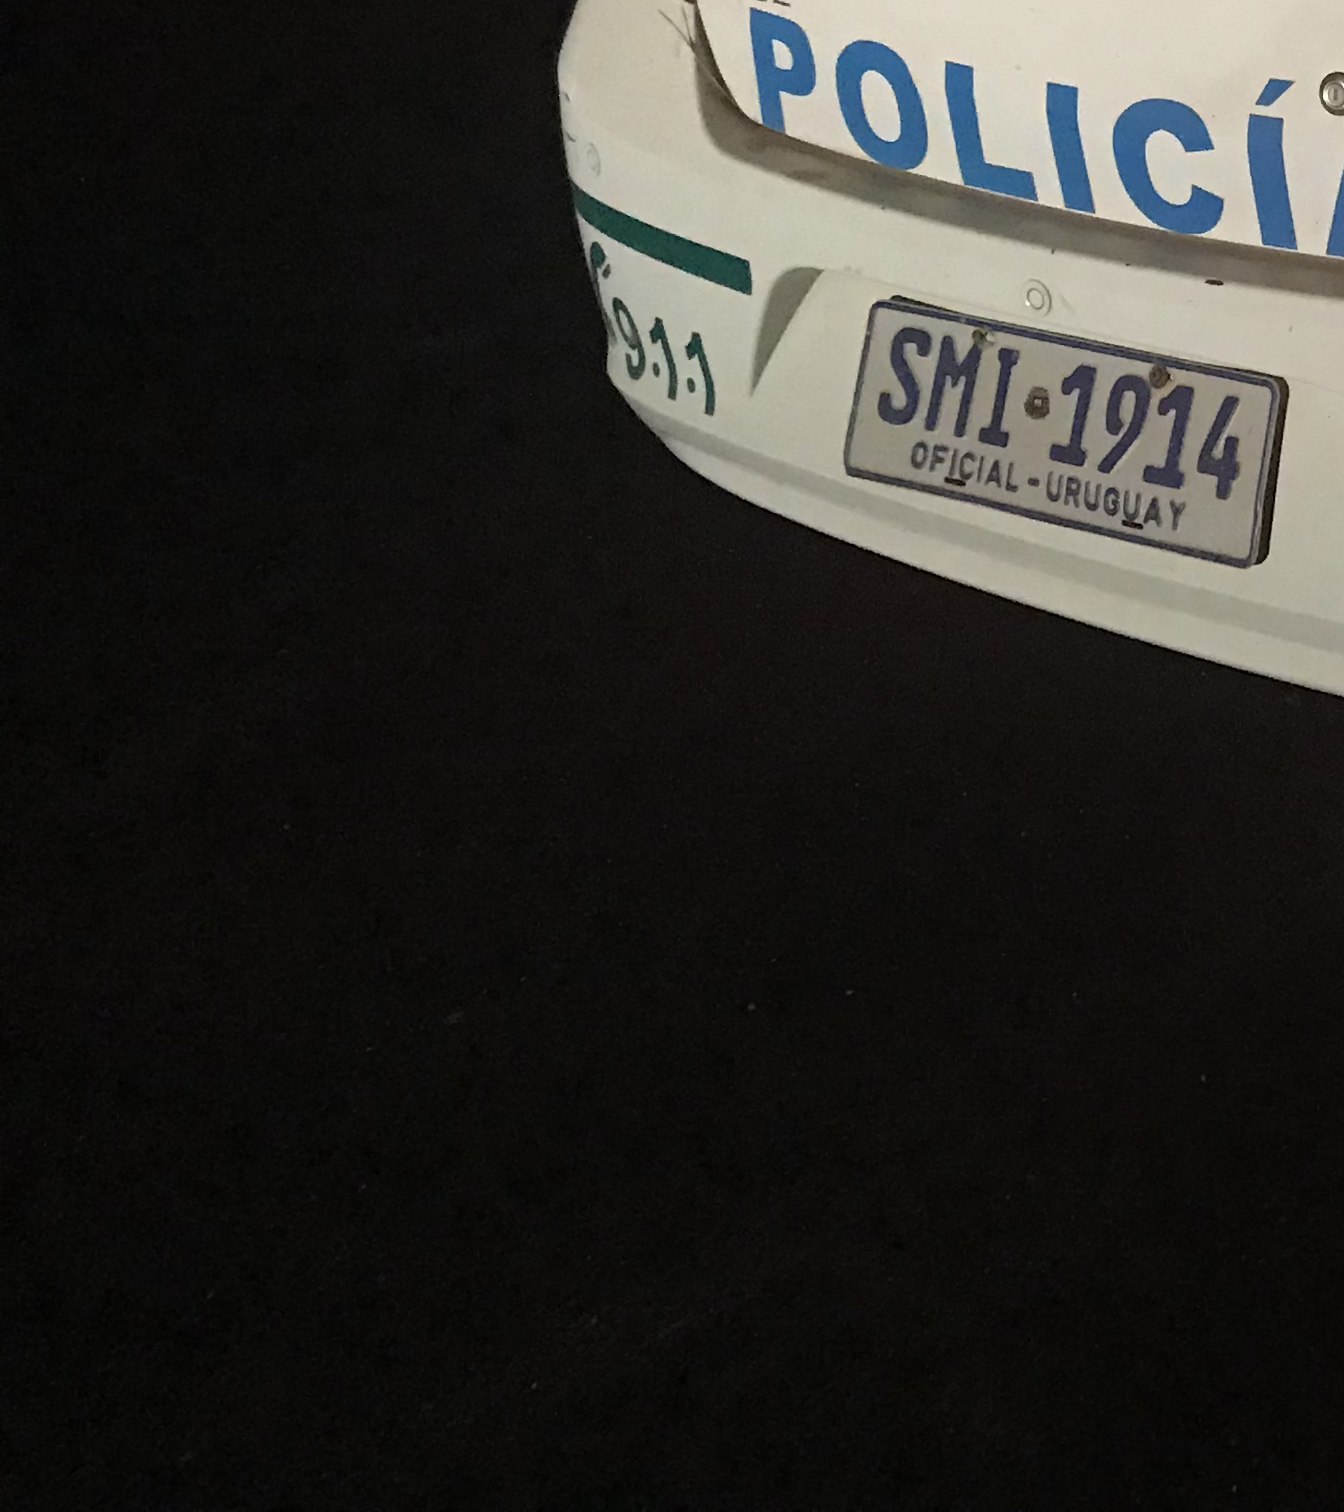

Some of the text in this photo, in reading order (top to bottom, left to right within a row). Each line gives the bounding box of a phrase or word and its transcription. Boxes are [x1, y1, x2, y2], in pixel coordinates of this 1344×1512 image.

[611, 296, 716, 417] 9.1.1
[877, 326, 1242, 501] SMI 1914
[910, 441, 1019, 491] OFICIAL
[1045, 472, 1187, 531] URUGUAY
